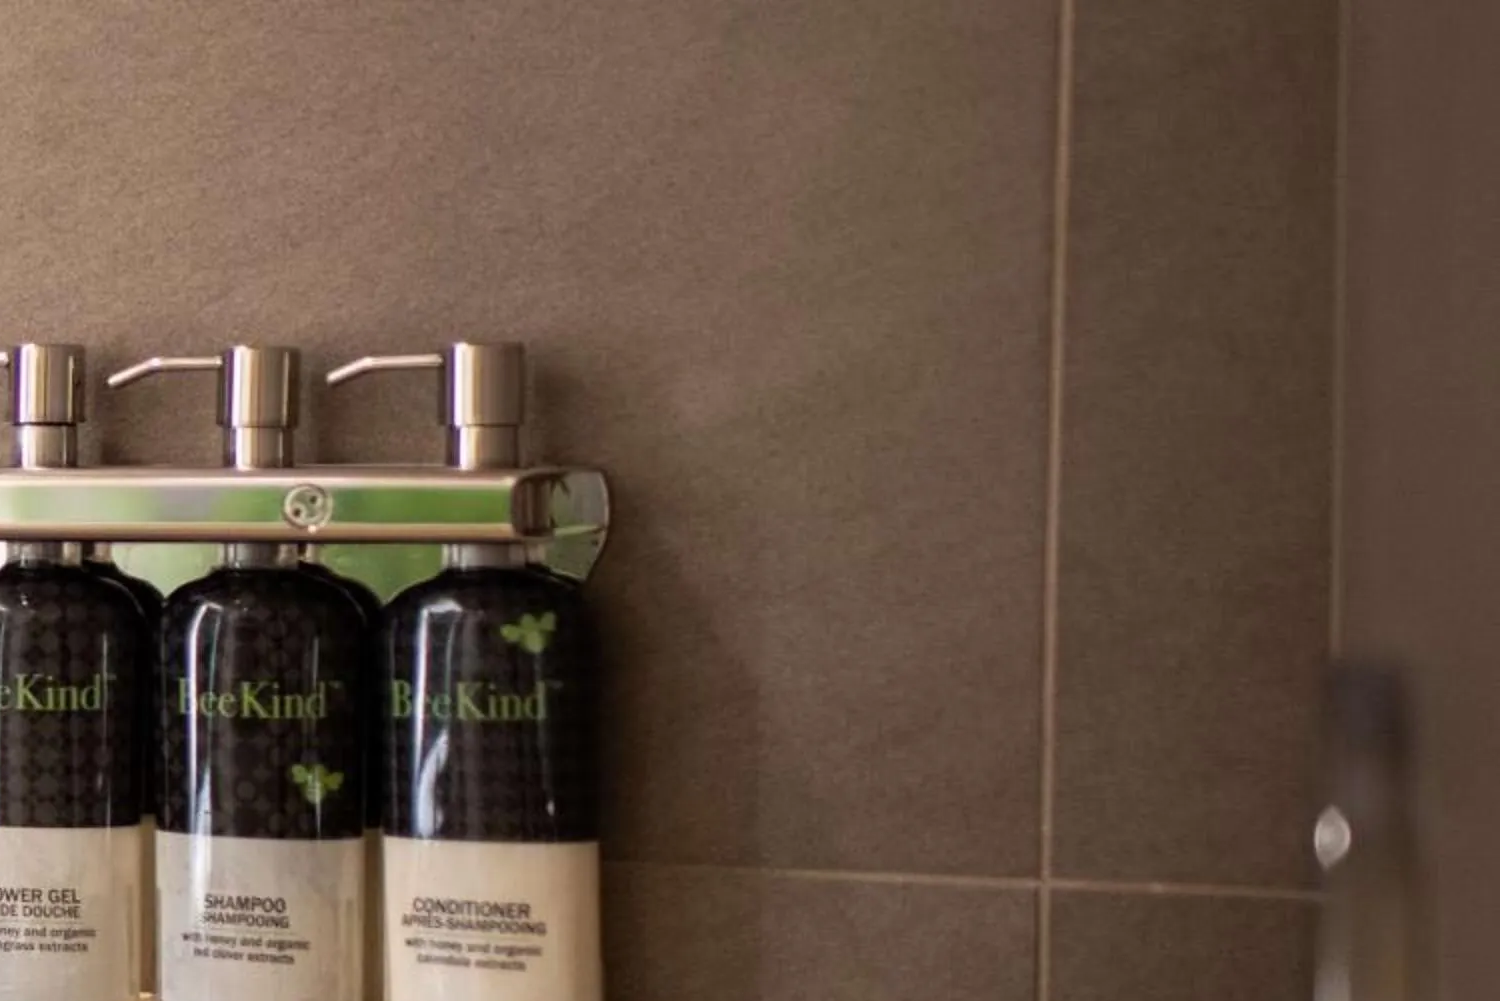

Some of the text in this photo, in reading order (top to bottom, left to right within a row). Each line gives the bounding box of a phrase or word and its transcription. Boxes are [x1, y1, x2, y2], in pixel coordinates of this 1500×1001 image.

[391, 679, 548, 721] BeKind
[47, 888, 81, 904] GEL
[204, 893, 287, 913] SHAMPOO
[0, 904, 19, 917] DE
[22, 905, 81, 919] DOUCHE
[412, 897, 532, 918] CONDITIONER
[201, 911, 290, 929] SHAMPOOING
[23, 926, 47, 938] and
